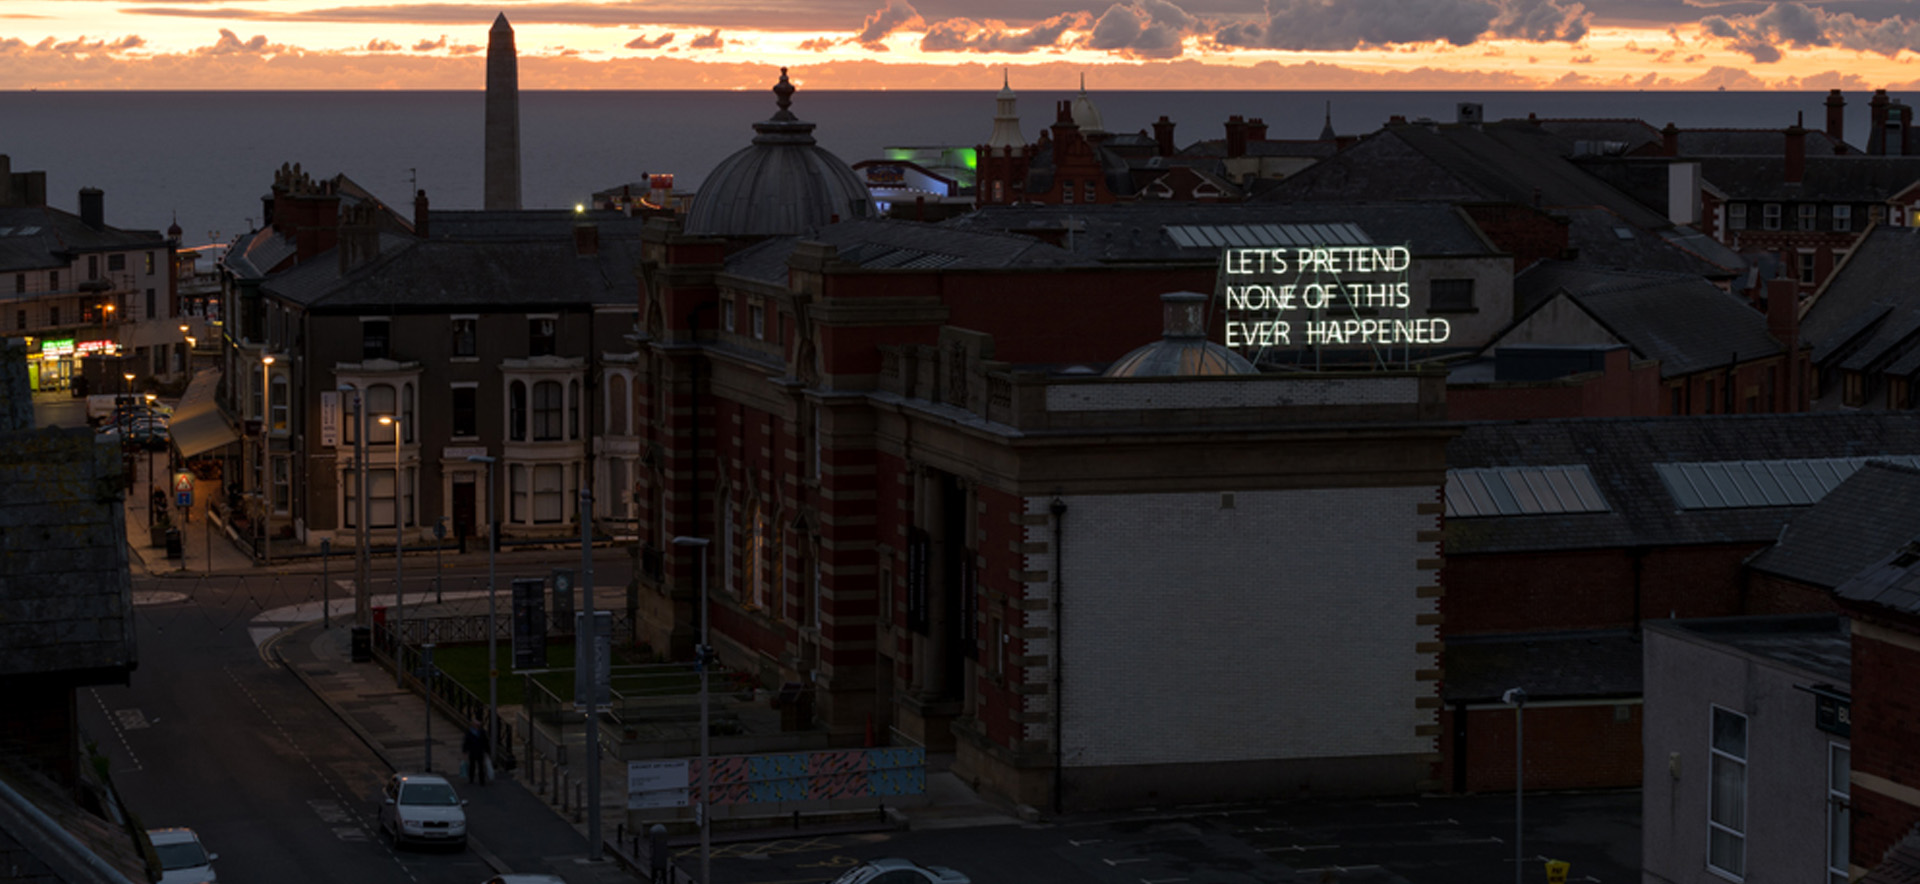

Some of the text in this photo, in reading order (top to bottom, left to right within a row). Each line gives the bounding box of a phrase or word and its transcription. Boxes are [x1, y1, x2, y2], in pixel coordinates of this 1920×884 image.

[1298, 246, 1411, 273] PRETEND
[1226, 282, 1411, 310] NONE OF THIS
[1226, 318, 1451, 347] EVER HAPPENED
